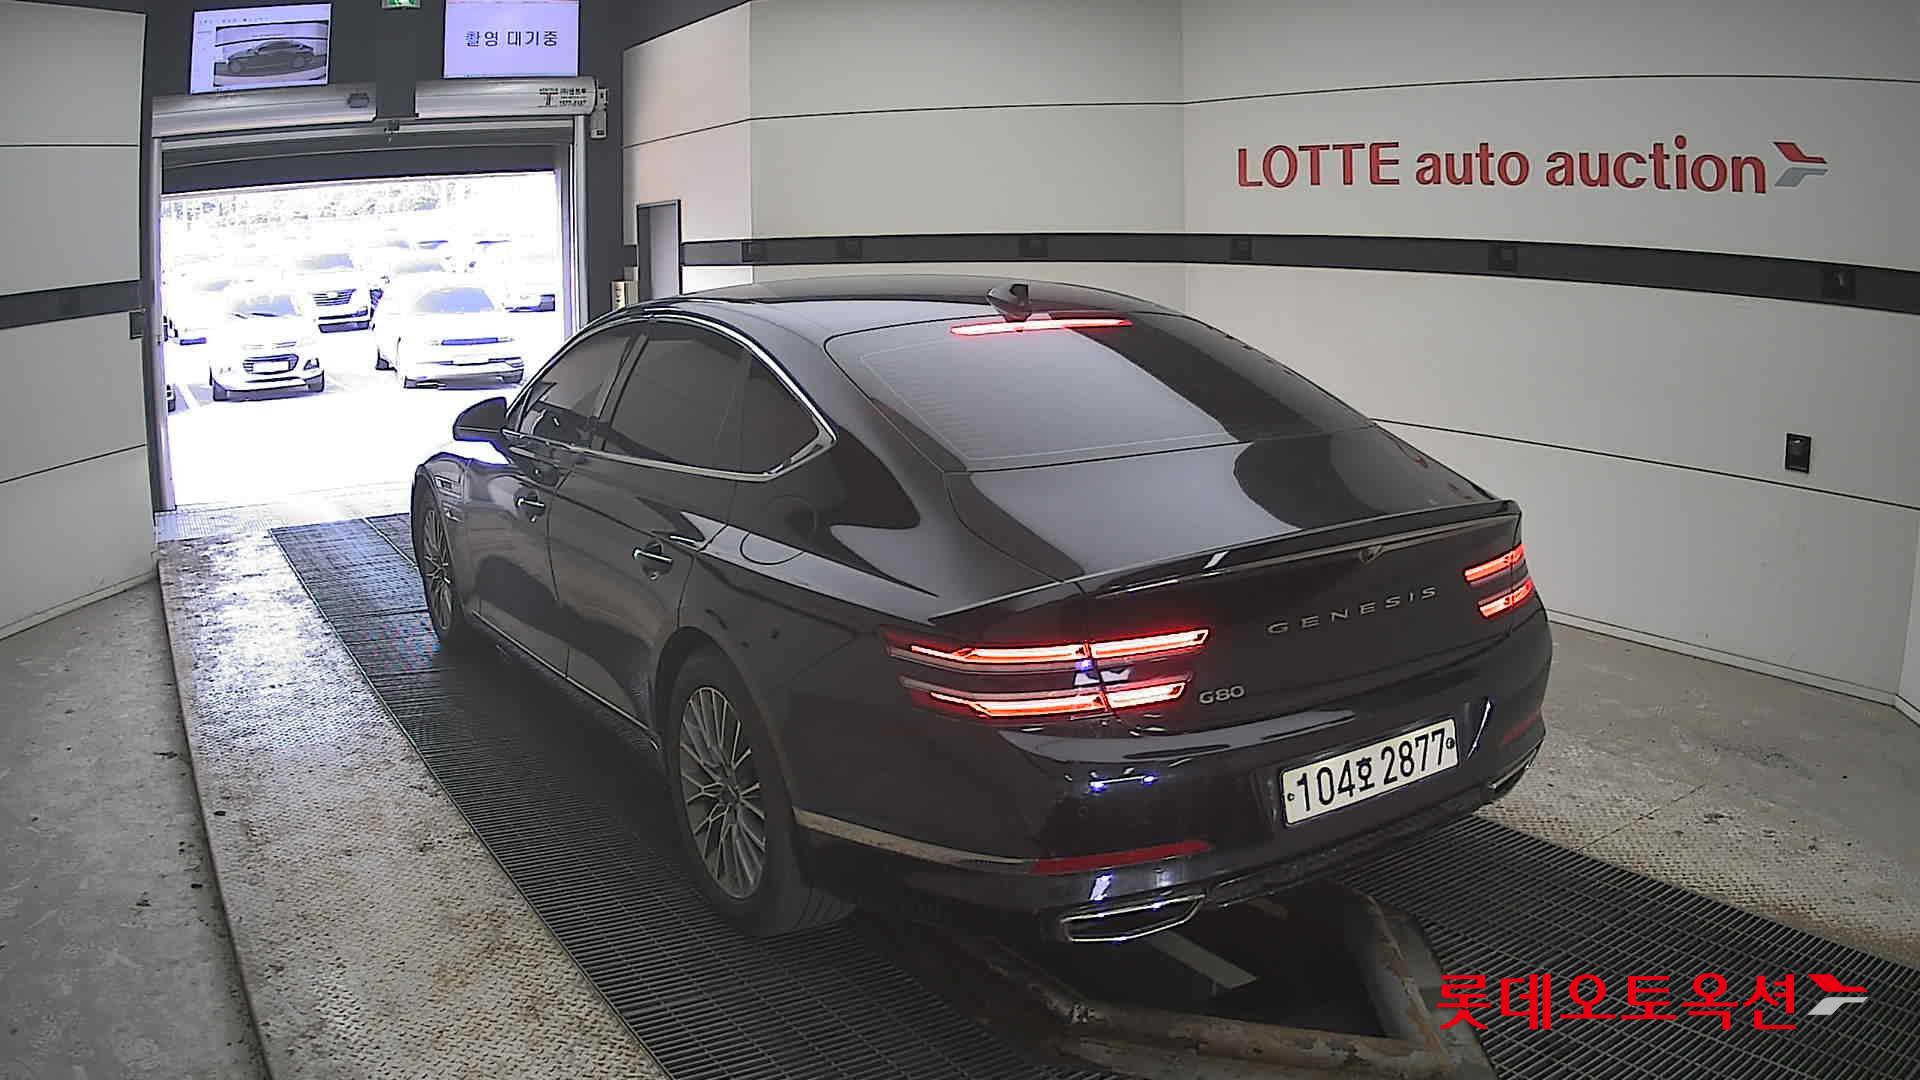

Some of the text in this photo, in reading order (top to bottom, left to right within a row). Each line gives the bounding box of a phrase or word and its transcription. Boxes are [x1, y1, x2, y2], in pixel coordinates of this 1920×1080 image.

[507, 31, 558, 47] 대기중
[1237, 135, 1767, 194] LOTTE auto auction
[1267, 585, 1437, 634] GENESIS
[1199, 684, 1246, 705] G80
